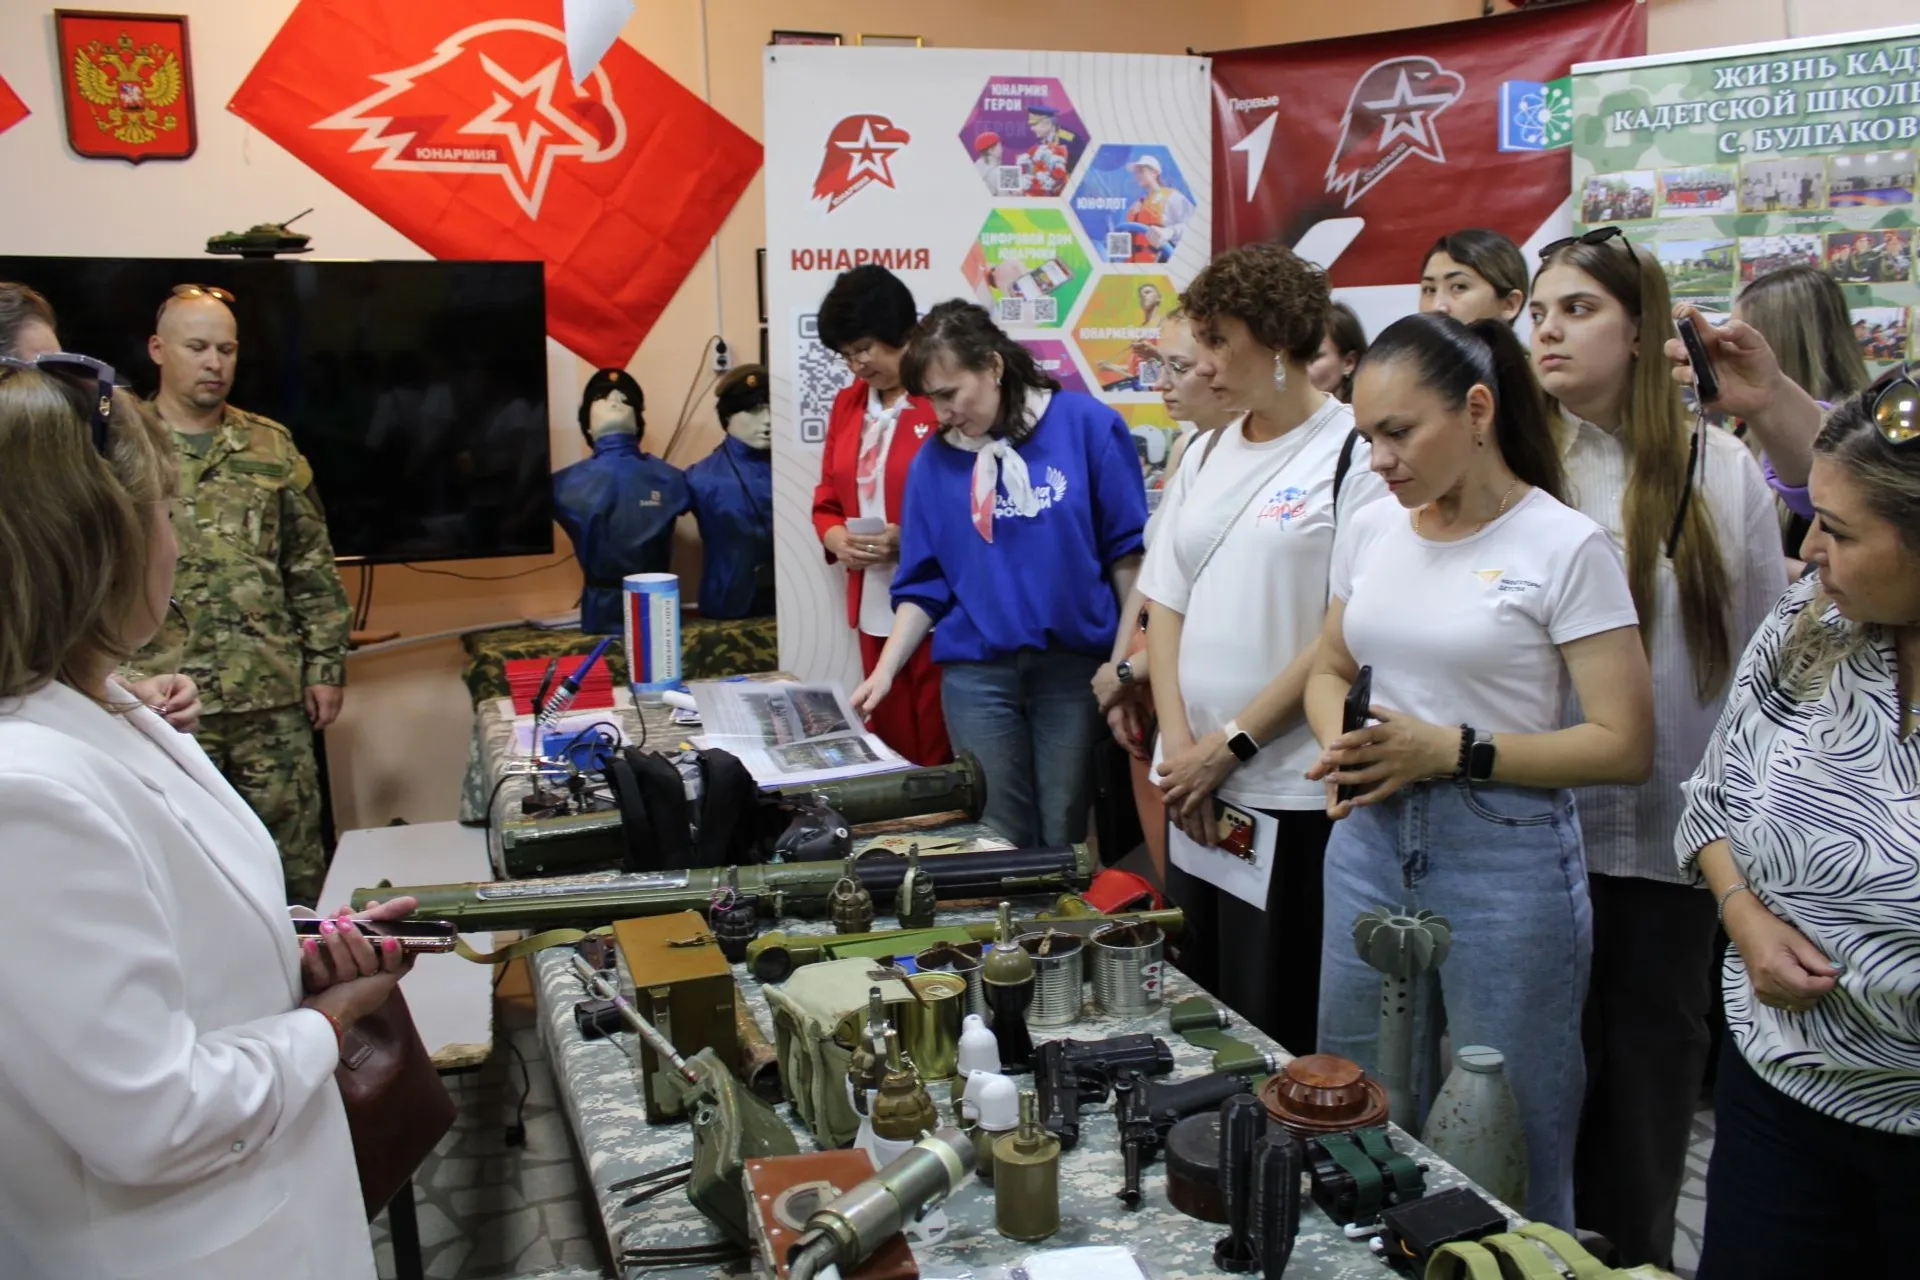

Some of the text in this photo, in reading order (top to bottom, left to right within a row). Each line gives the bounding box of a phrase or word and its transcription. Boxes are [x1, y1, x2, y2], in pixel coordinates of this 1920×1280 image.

[1713, 45, 1920, 90] ЖИЗНЬ КАД
[1613, 88, 1796, 133] КАДЕТСКОЙ
[416, 147, 497, 161] ЮНАРМИЯ
[1719, 131, 1746, 154] С.
[790, 247, 930, 271] ЮНАРМИЯ
